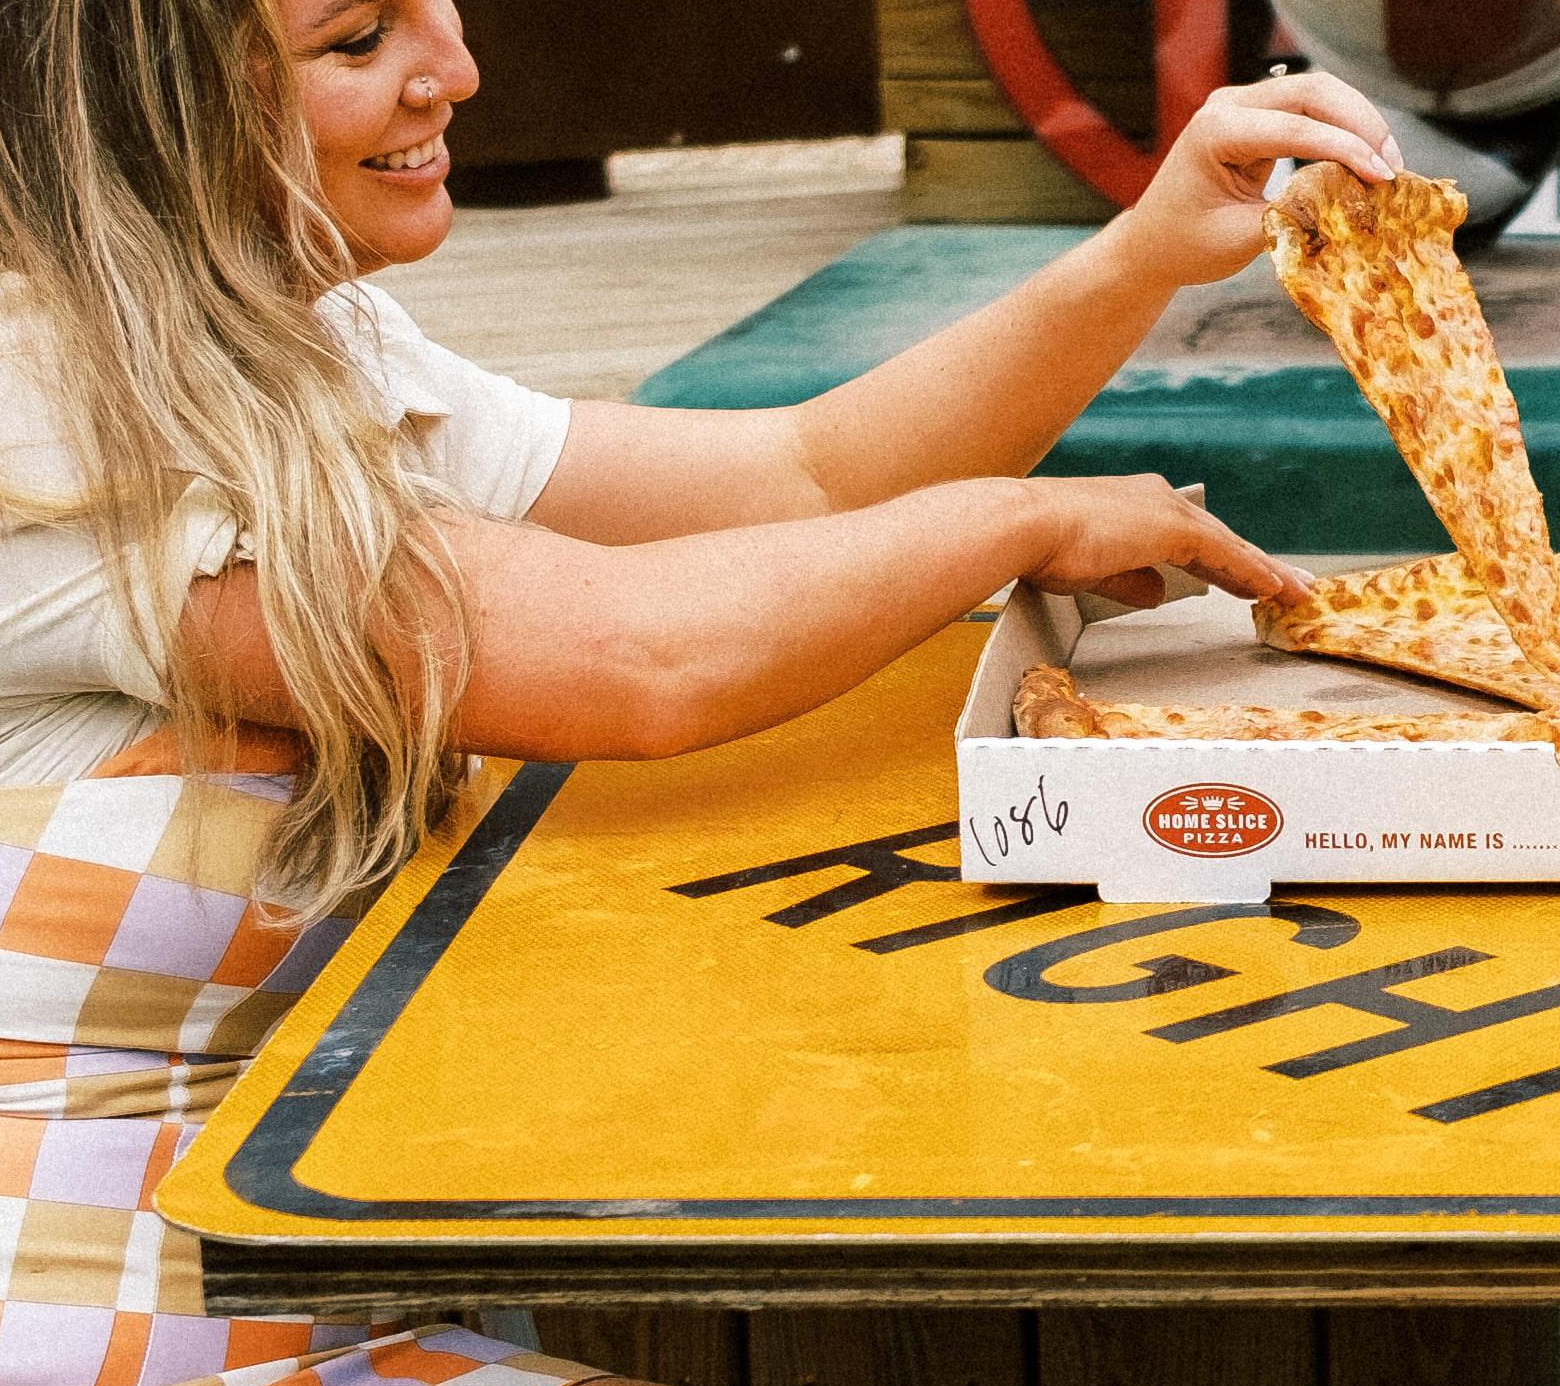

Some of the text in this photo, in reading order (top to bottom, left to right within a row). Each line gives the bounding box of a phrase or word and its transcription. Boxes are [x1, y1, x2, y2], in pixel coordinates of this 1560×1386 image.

[969, 774, 1069, 867] 1086
[1158, 813, 1269, 830] HOME SLICE
[1182, 832, 1244, 845] PIZZA
[1304, 832, 1505, 853] HELLO, MY NAME IS
